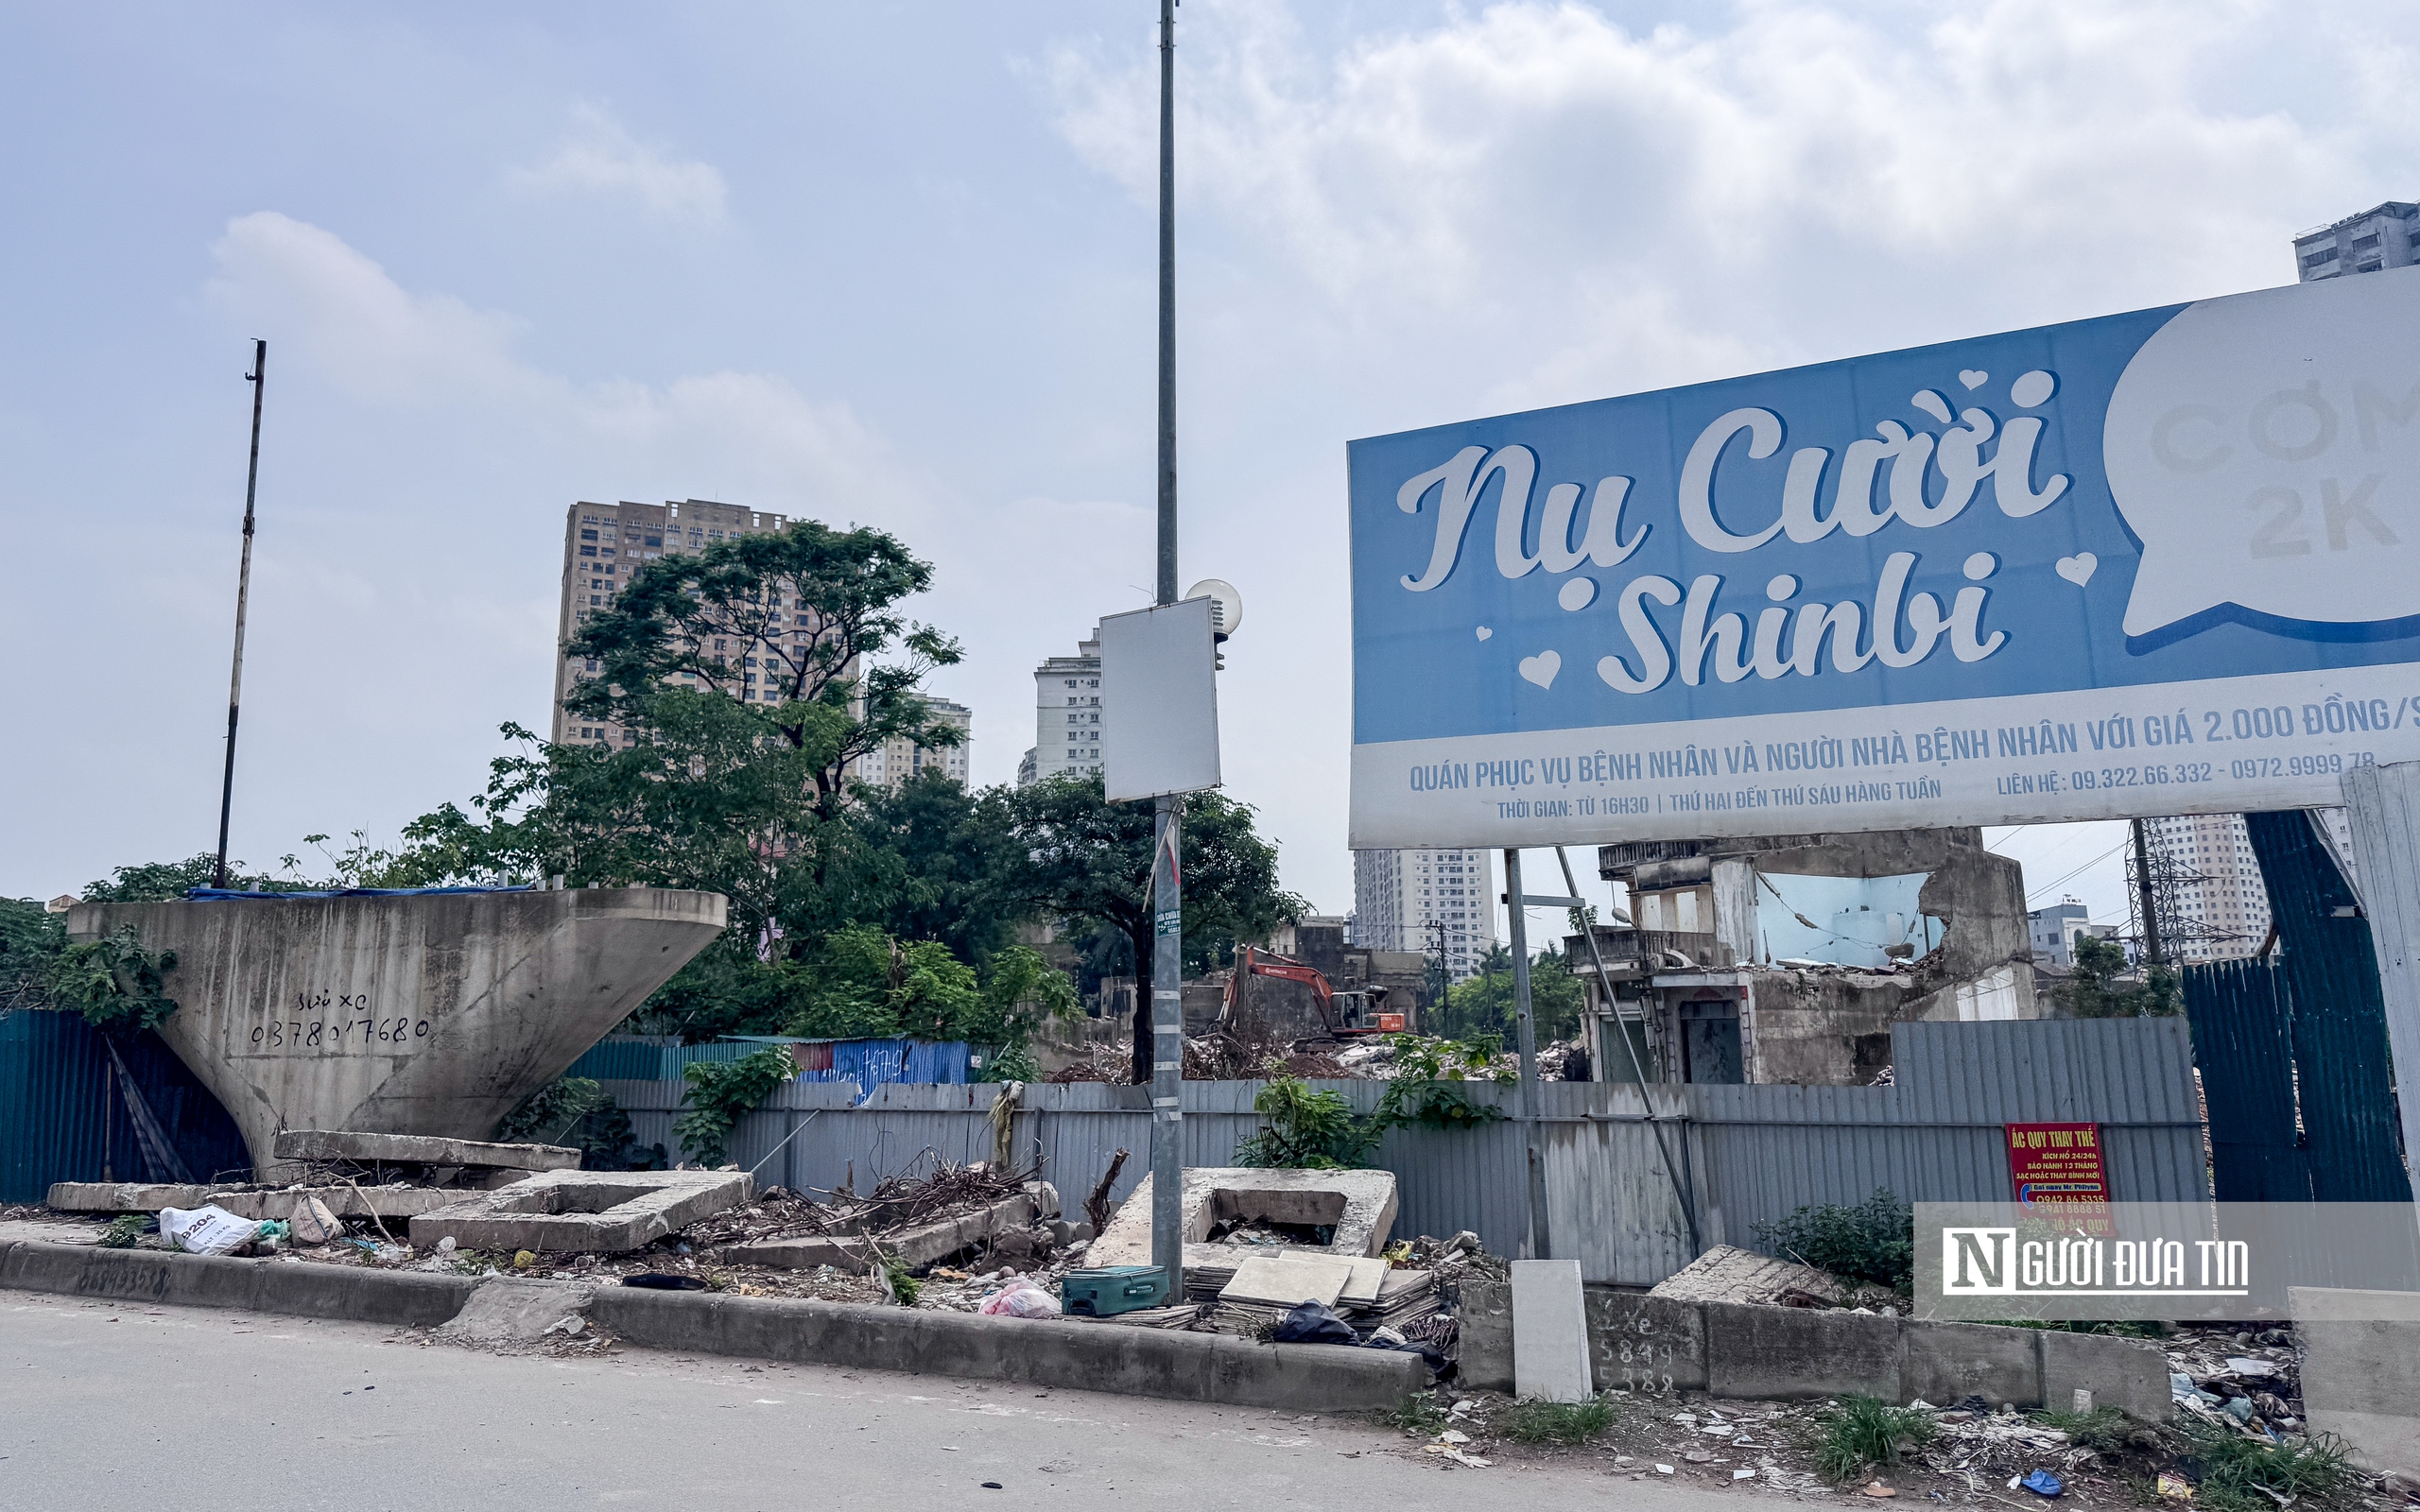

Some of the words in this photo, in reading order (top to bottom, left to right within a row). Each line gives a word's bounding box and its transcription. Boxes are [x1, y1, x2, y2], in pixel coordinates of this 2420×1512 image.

[1396, 444, 1653, 612] Nụ
[1679, 369, 2075, 554] Cười
[1597, 551, 2012, 695] Shinbi
[1410, 759, 1469, 792] QUÁN
[1476, 759, 1535, 791] PHỤC
[1540, 757, 1572, 789] VỤ
[1579, 749, 1641, 786] BỆNH
[1649, 744, 1718, 779] NHÂN
[1724, 740, 1759, 774] VÀ
[1766, 734, 1844, 772] NGƯỜI
[1851, 730, 1909, 766] NHÀ
[1915, 726, 1990, 766] BỆNH
[1997, 718, 2078, 758] NHÂN
[2086, 713, 2135, 750] VỚI
[2144, 708, 2194, 747] GIÁ
[2204, 706, 2294, 742] 2.000
[1497, 798, 1530, 818] THỜI
[1533, 800, 1573, 817] GIAN:
[1576, 795, 1595, 816] TỪ
[1601, 797, 1650, 816] 16H30
[1669, 790, 1701, 812] THỨ
[1704, 792, 1731, 811] HAI
[1736, 784, 1768, 809] ĐẾN
[1772, 783, 1804, 806] THỨ
[1808, 782, 1841, 804] SÁU
[1845, 781, 1892, 803] HÀNG
[1895, 775, 1942, 799] TUẦN
[1996, 773, 2033, 796] LIÊN
[2071, 762, 2212, 791] 09.322.66.332
[251, 1018, 429, 1047] 0378017680
[2028, 1131, 2047, 1149] QUY
[2048, 1130, 2073, 1147] THAY
[2075, 1125, 2096, 1147] THẾ
